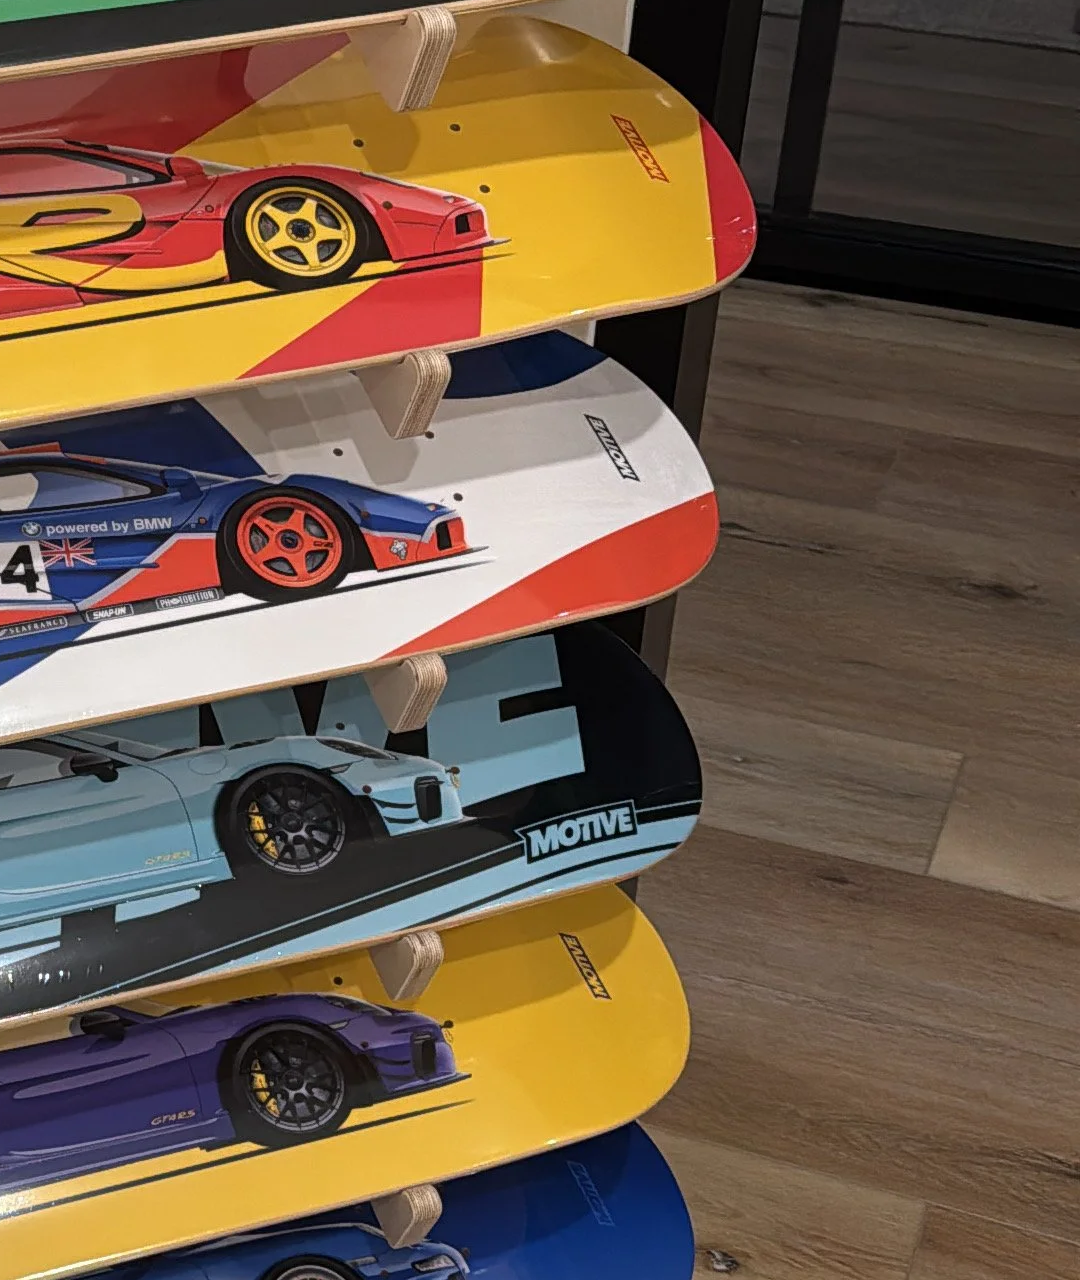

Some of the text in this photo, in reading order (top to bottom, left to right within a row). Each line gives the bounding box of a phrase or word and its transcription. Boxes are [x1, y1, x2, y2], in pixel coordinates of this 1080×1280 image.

[587, 417, 638, 479] MOTIVE
[45, 517, 172, 536] powered by BMW
[526, 806, 634, 858] MOTIVE
